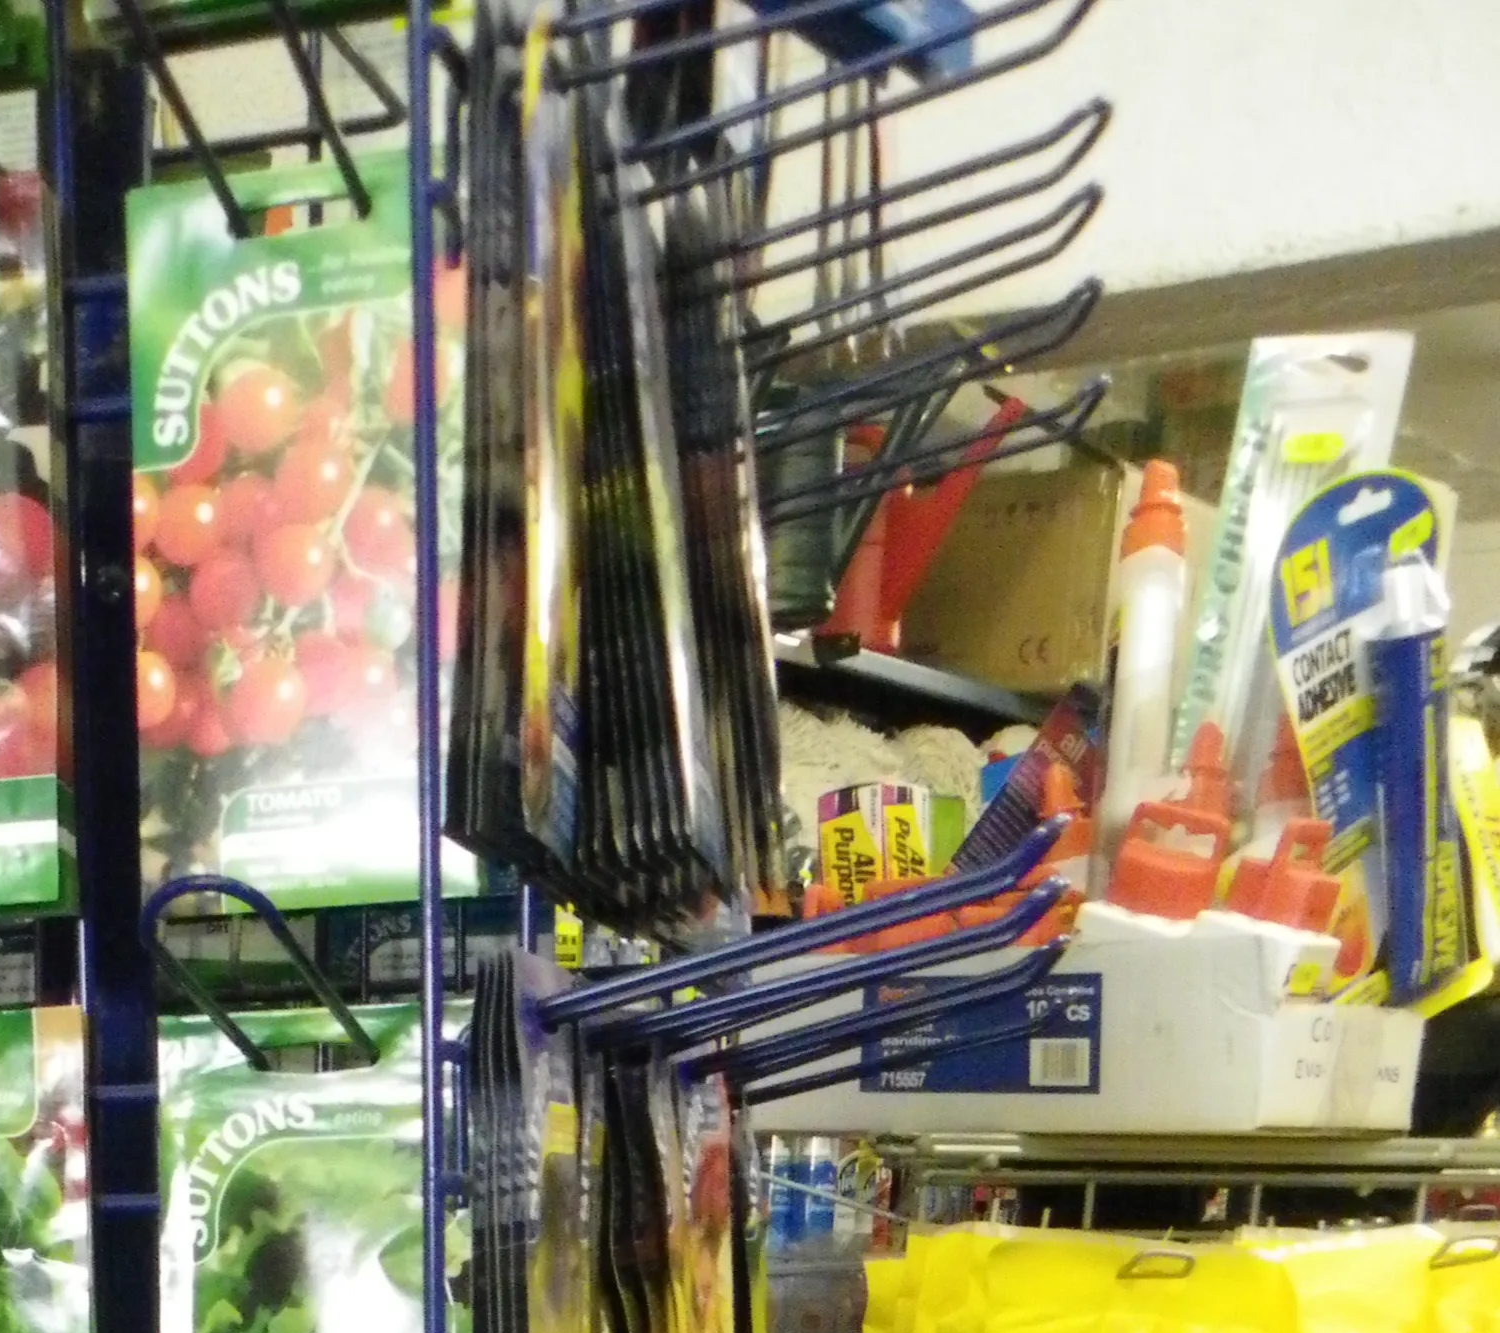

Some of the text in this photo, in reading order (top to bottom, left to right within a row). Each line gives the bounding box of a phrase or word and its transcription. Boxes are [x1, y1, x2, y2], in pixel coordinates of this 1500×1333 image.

[153, 261, 301, 447] SUTTONS
[1293, 627, 1351, 688] CONTACT
[188, 1095, 315, 1248] SUTTONS
